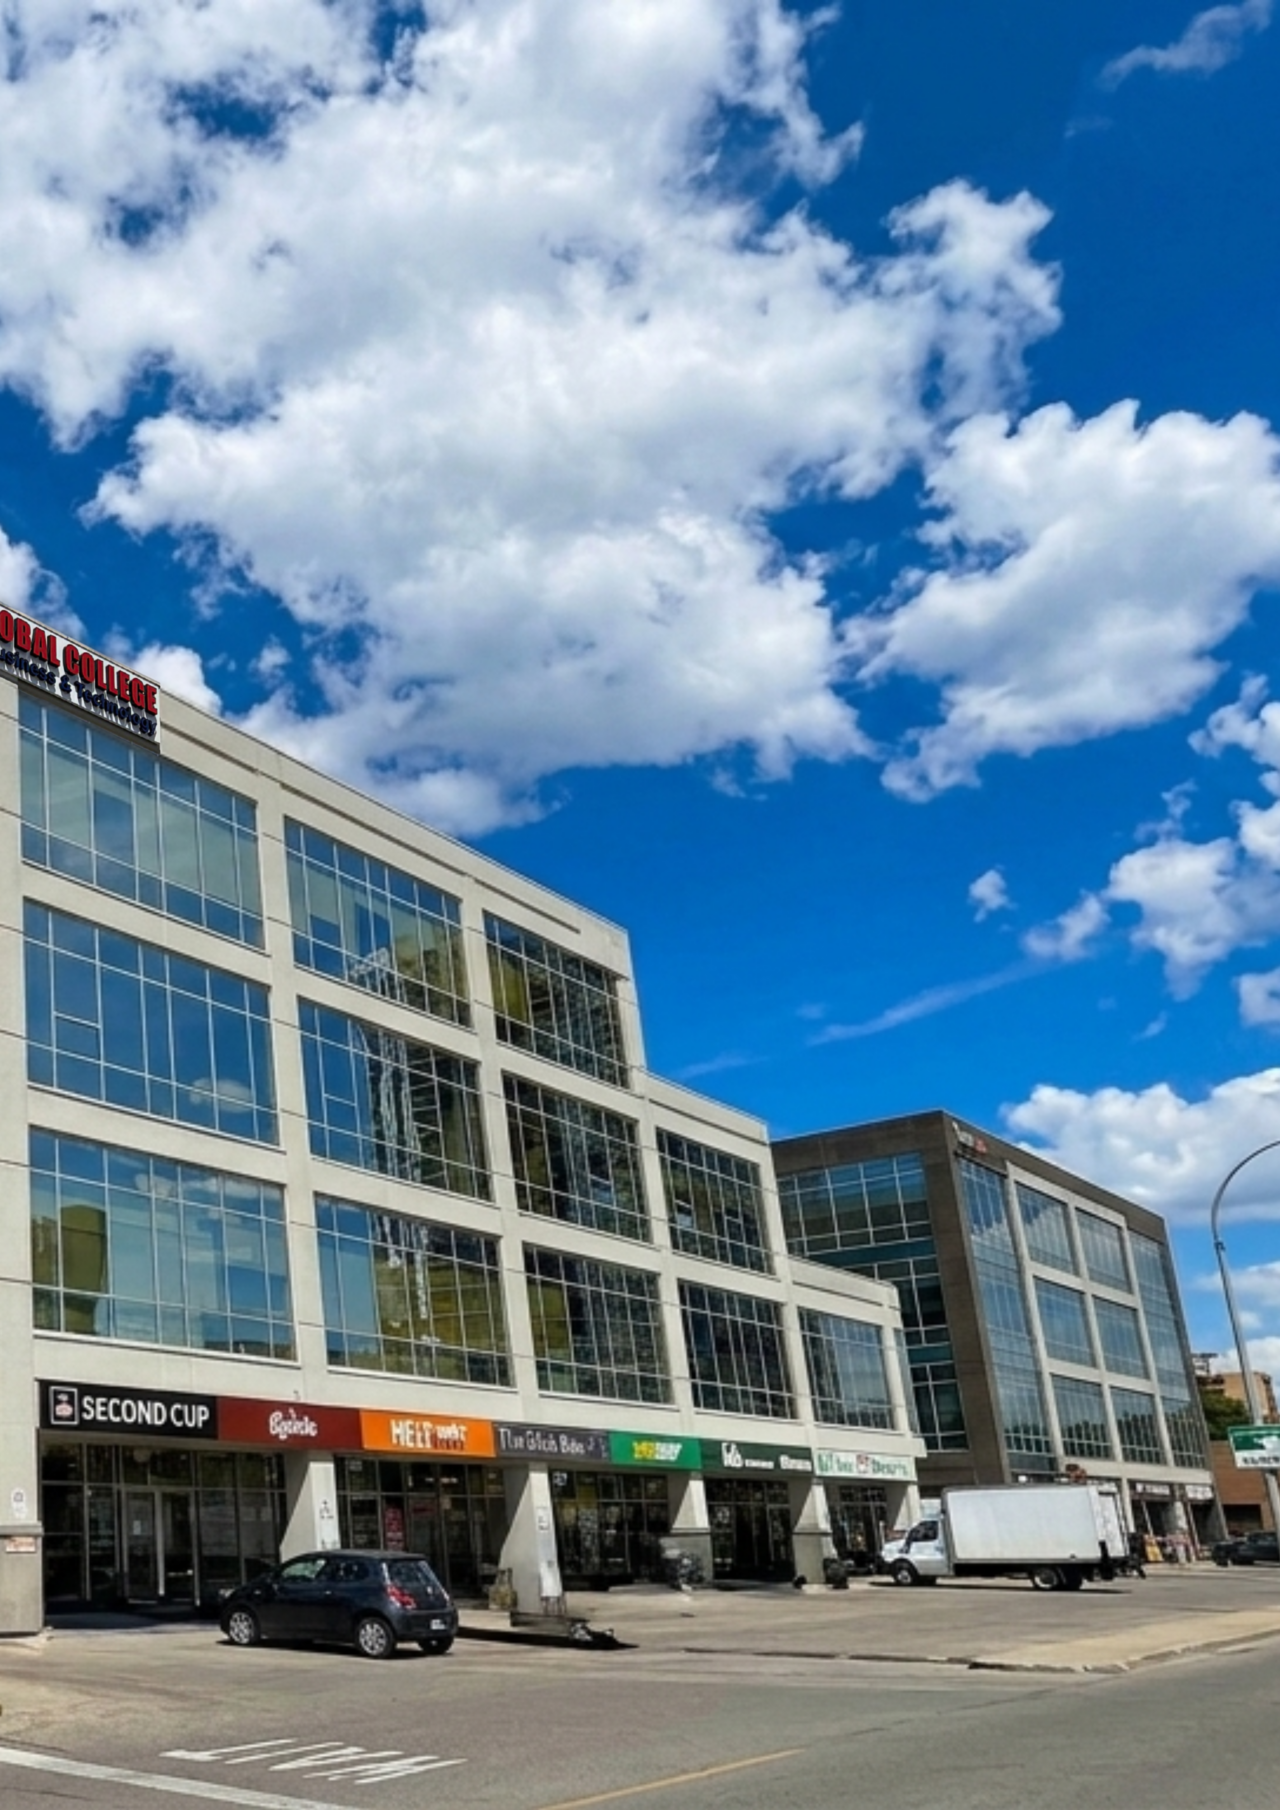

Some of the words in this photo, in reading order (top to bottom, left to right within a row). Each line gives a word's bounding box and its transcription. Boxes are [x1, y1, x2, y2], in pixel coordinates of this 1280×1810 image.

[58, 674, 72, 693] &
[73, 680, 158, 736] Technology
[63, 643, 158, 715] COLLEGE
[82, 1395, 167, 1426] SECOND
[170, 1403, 210, 1428] CUP
